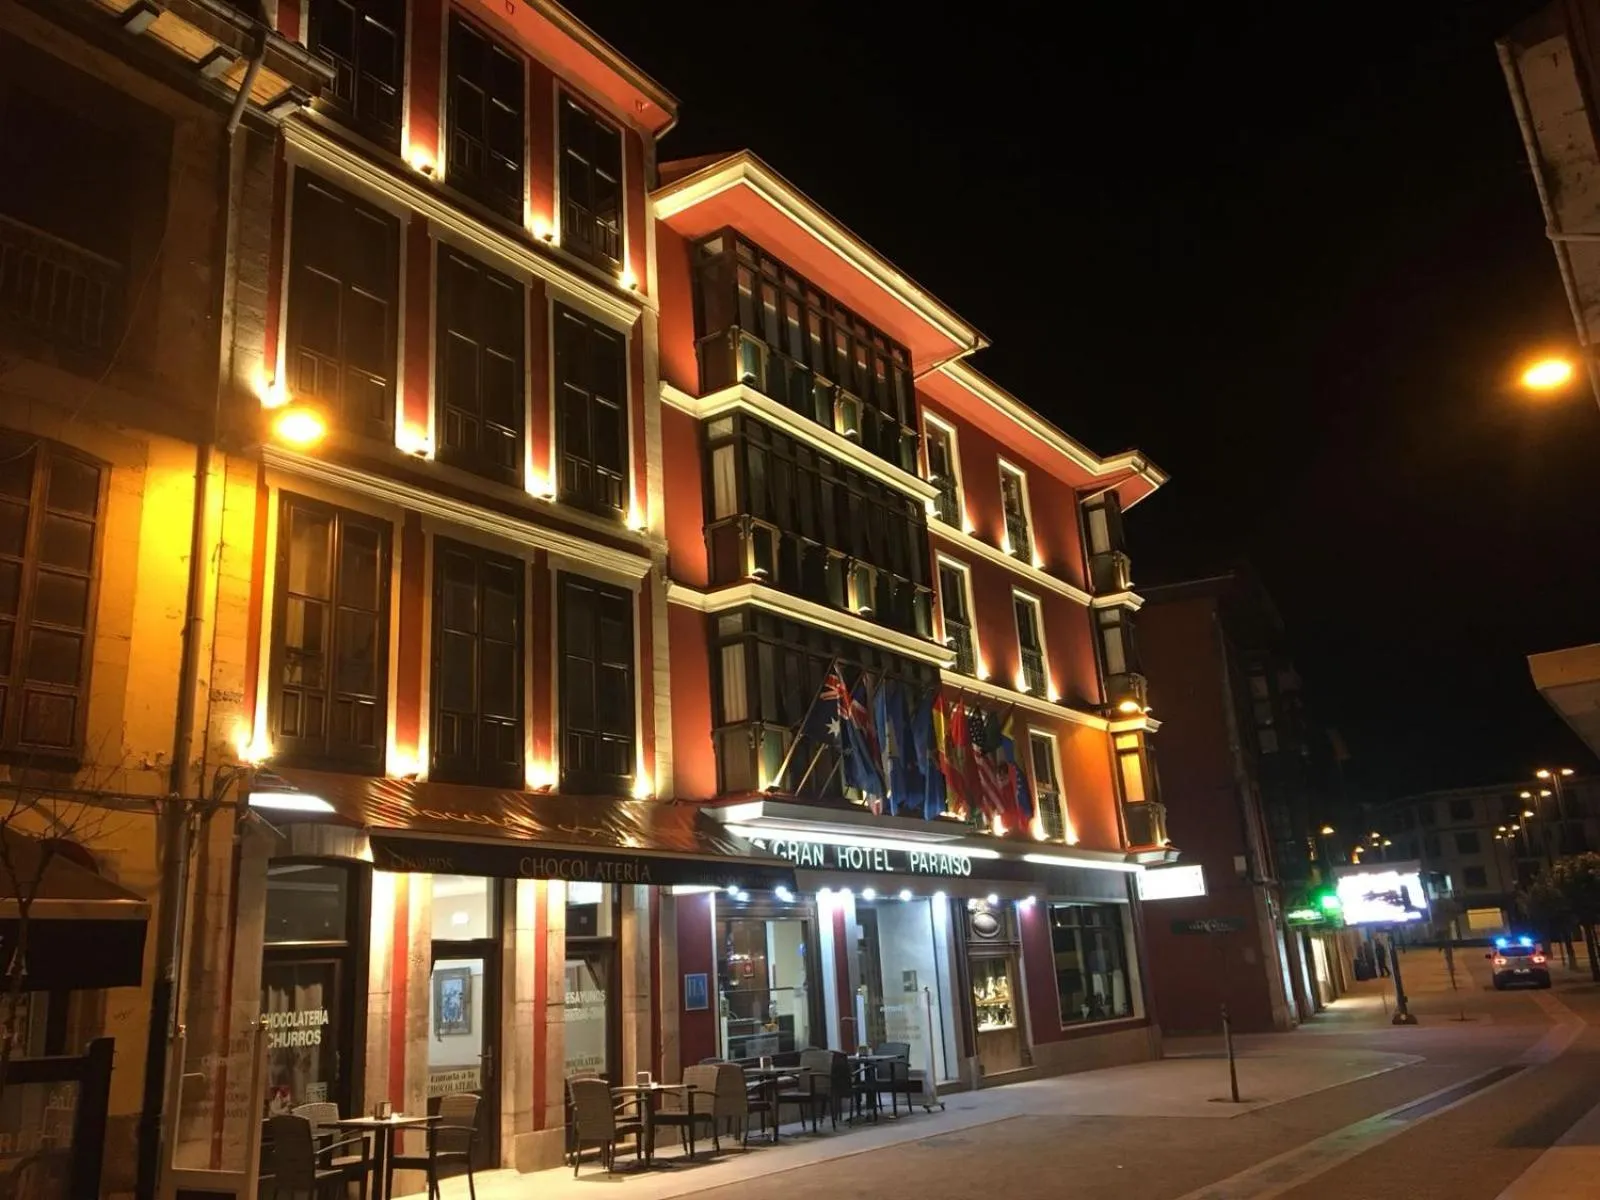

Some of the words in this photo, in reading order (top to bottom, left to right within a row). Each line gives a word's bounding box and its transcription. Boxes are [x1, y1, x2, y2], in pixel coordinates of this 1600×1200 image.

[773, 838, 825, 867] GRAN
[837, 846, 894, 872] HOTEL
[910, 851, 972, 877] PARAISO
[266, 1030, 322, 1049] CHURROS
